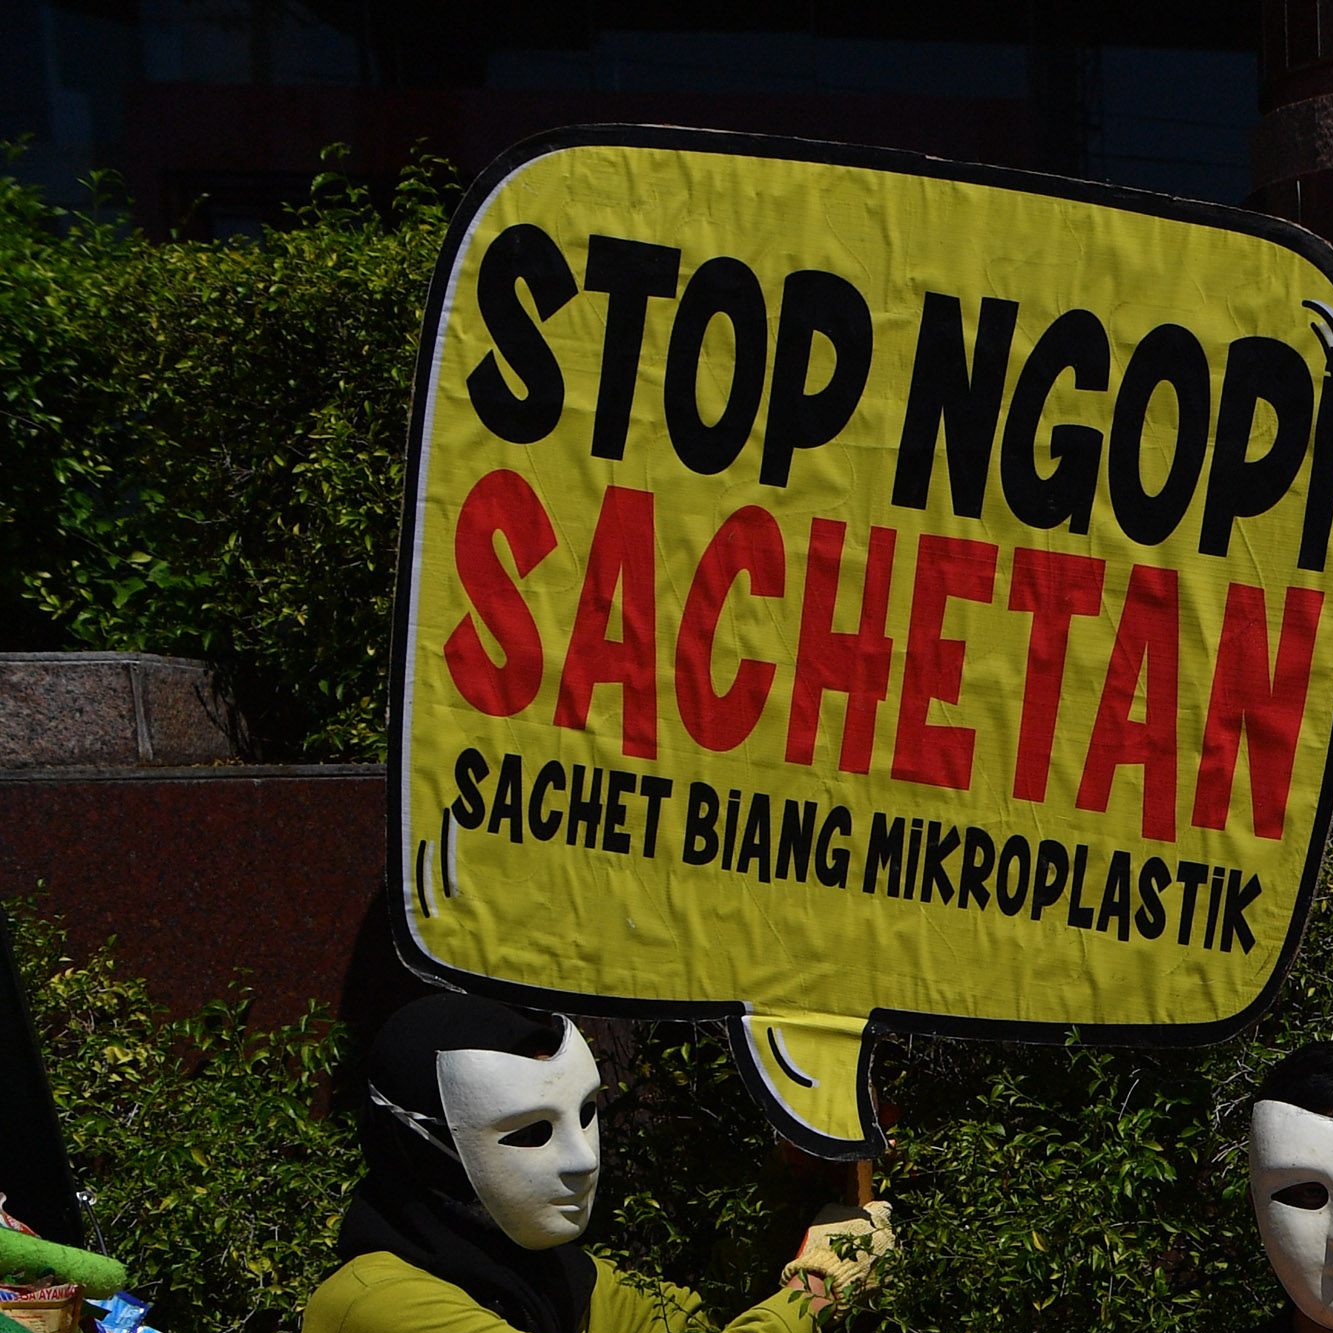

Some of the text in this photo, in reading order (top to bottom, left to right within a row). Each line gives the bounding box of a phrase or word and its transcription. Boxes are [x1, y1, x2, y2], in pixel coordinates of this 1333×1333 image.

[466, 223, 873, 488] STOP
[443, 468, 1325, 843] SACHETAN
[450, 747, 673, 859] SACHET
